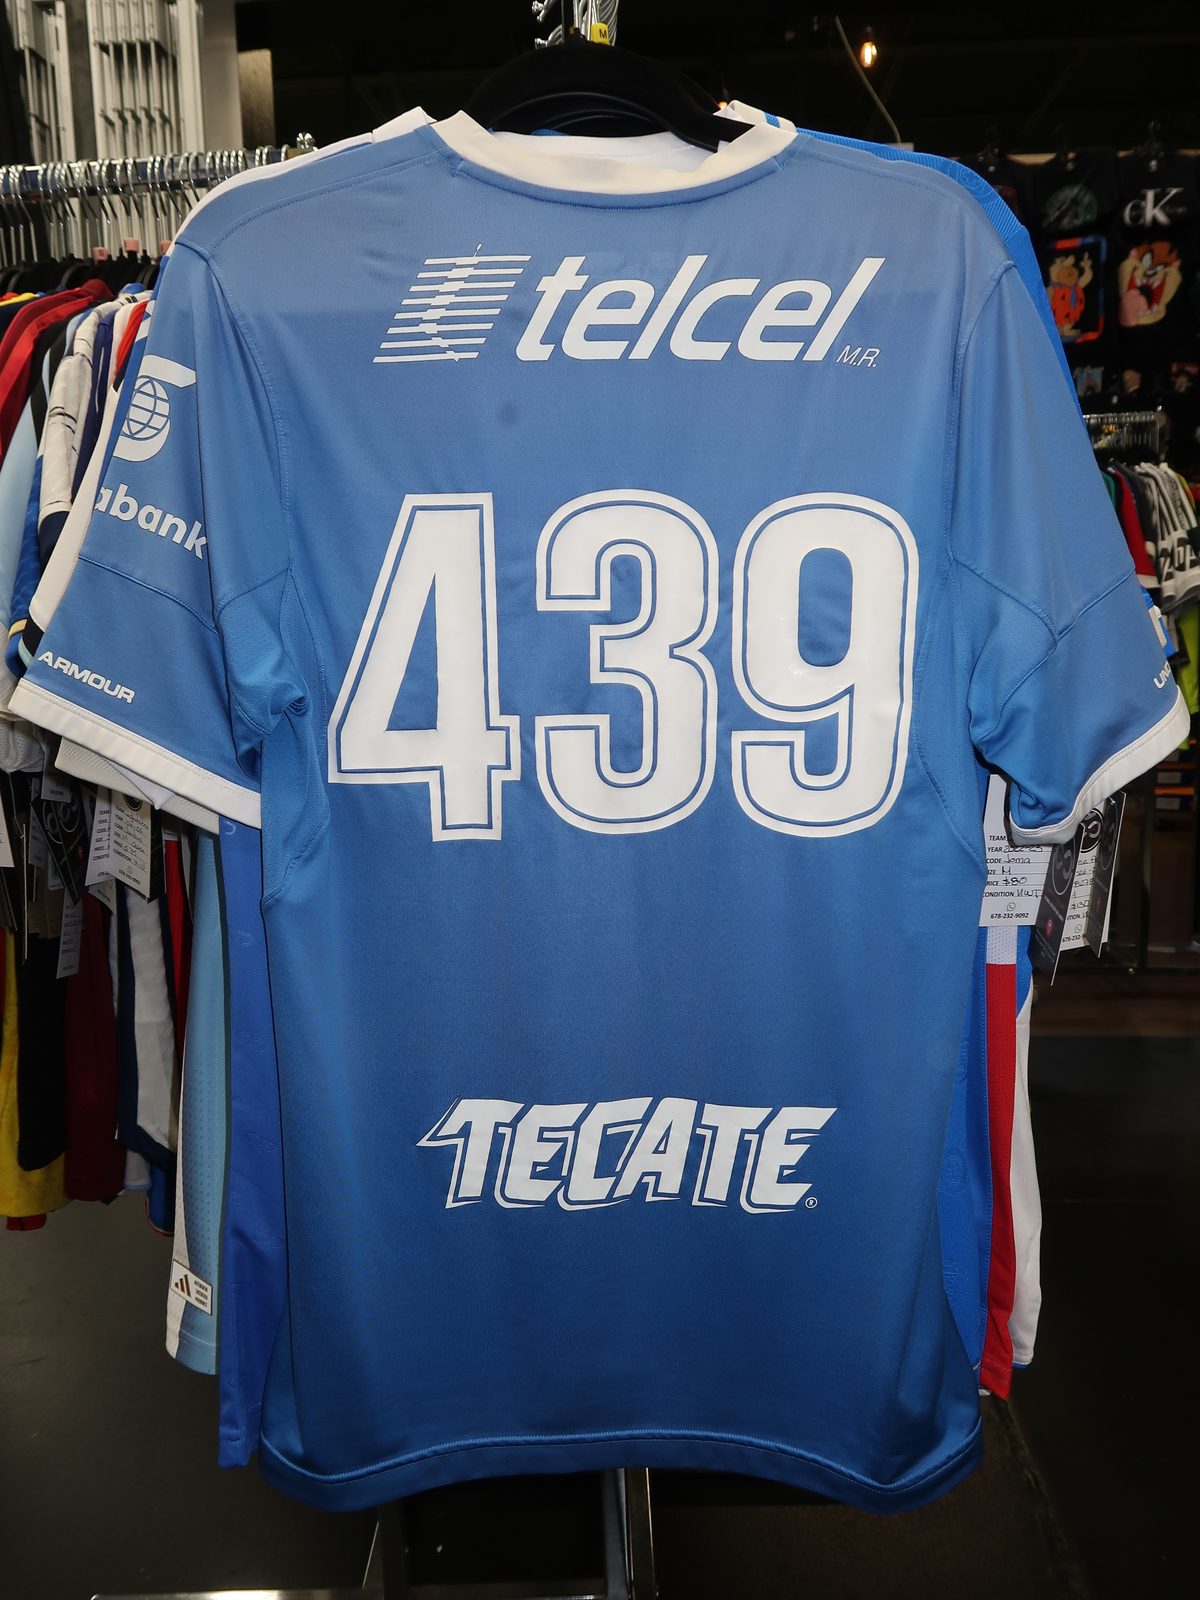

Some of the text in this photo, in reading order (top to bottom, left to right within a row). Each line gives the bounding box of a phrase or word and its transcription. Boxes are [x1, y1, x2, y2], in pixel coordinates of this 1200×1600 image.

[599, 28, 608, 39] M
[515, 254, 887, 362] telcel
[836, 345, 881, 368] M.R.
[37, 650, 136, 704] ARMOUR
[328, 487, 920, 842] 439
[1002, 876, 1028, 887] $80
[415, 1096, 839, 1215] TECATE
